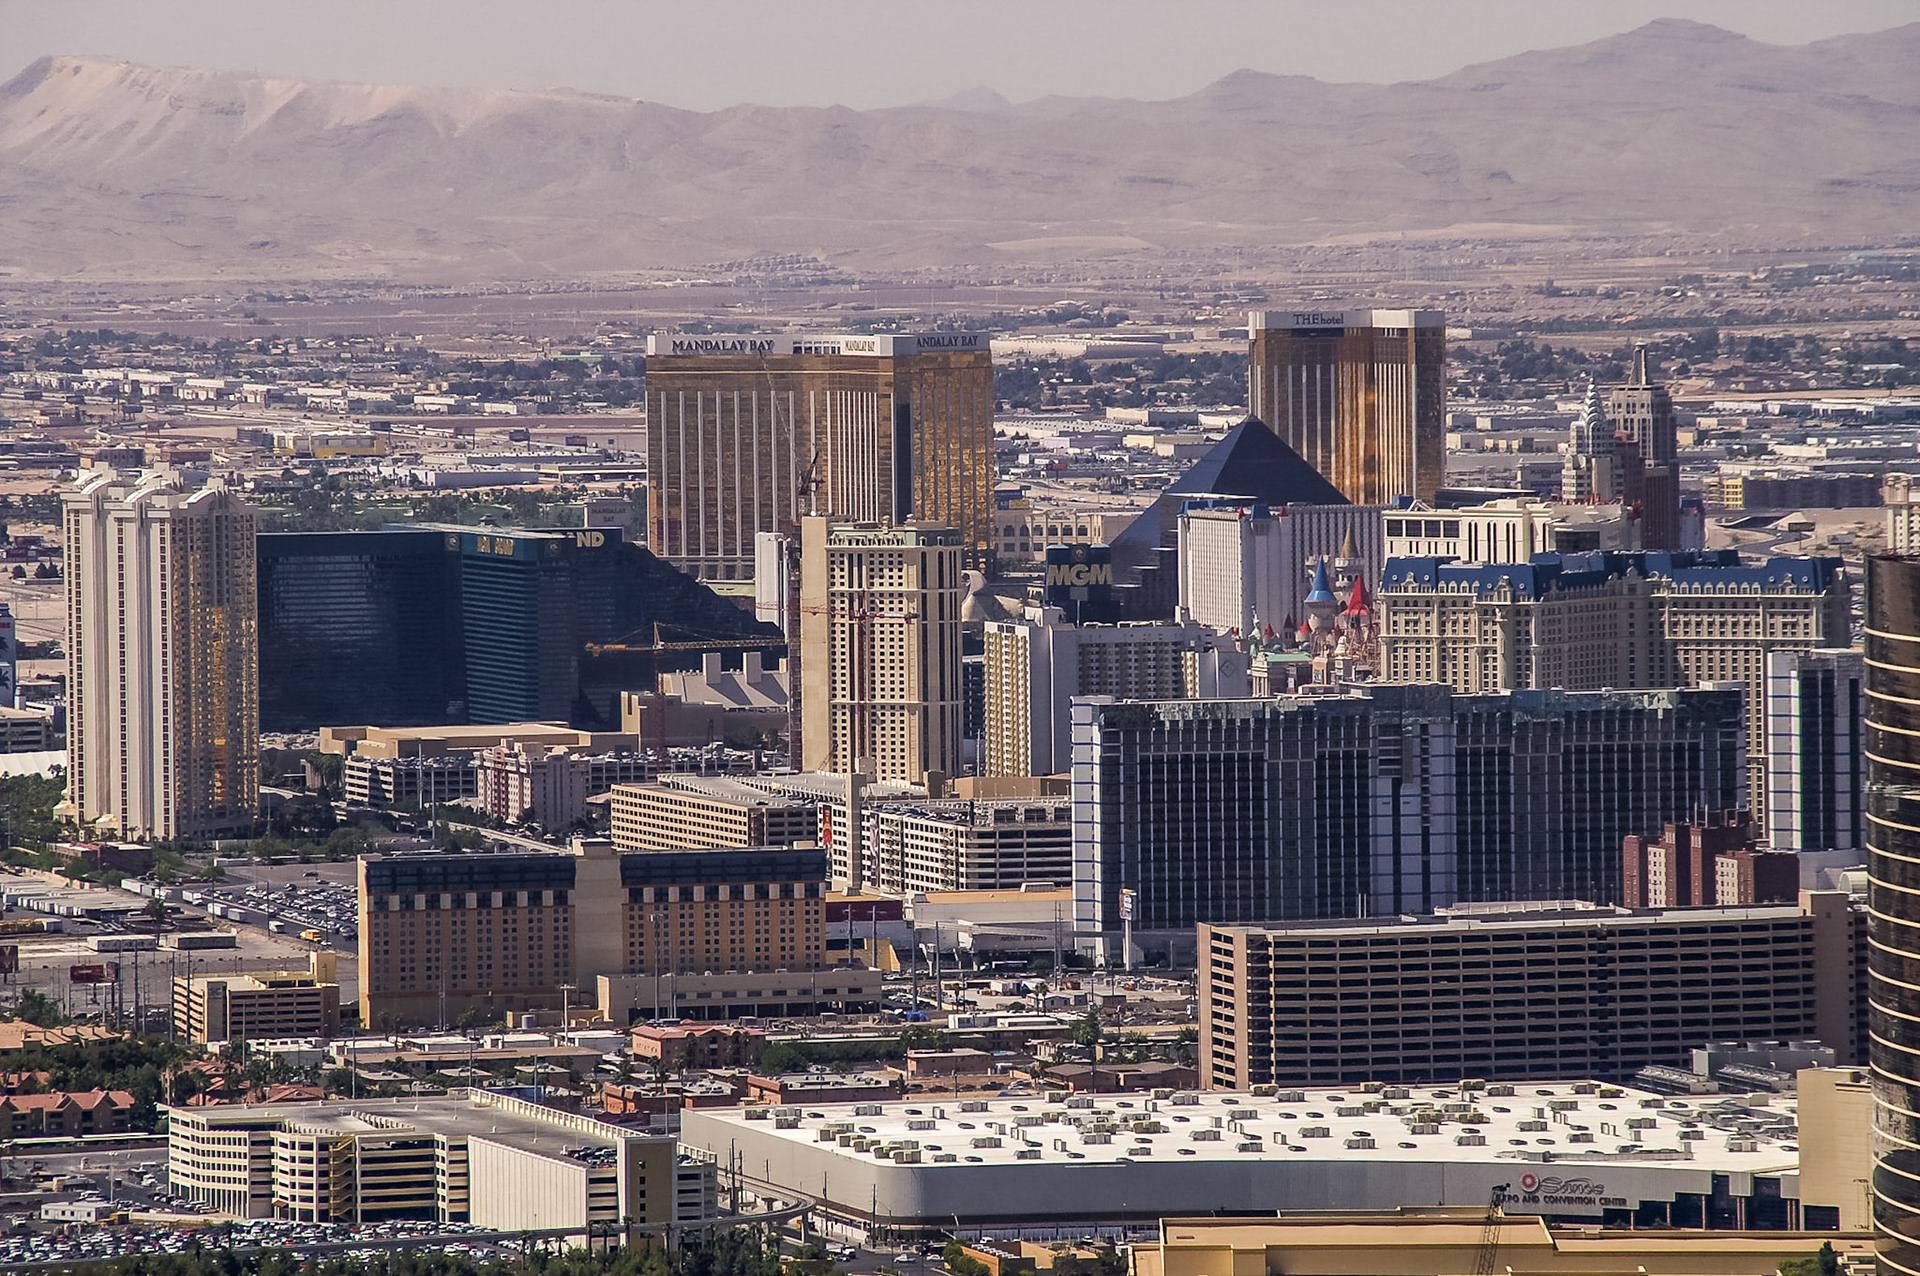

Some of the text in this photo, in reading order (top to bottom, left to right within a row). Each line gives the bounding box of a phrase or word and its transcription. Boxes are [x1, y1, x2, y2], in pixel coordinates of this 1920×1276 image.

[672, 340, 774, 351] MANDALAY BAY
[844, 339, 876, 352] MANDALAY BAY
[961, 335, 978, 347] BAY
[1047, 563, 1114, 587] MGM
[1522, 1195, 1540, 1205] AND
[1543, 1195, 1597, 1206] CONVENTION
[1599, 1197, 1628, 1207] CENTER
